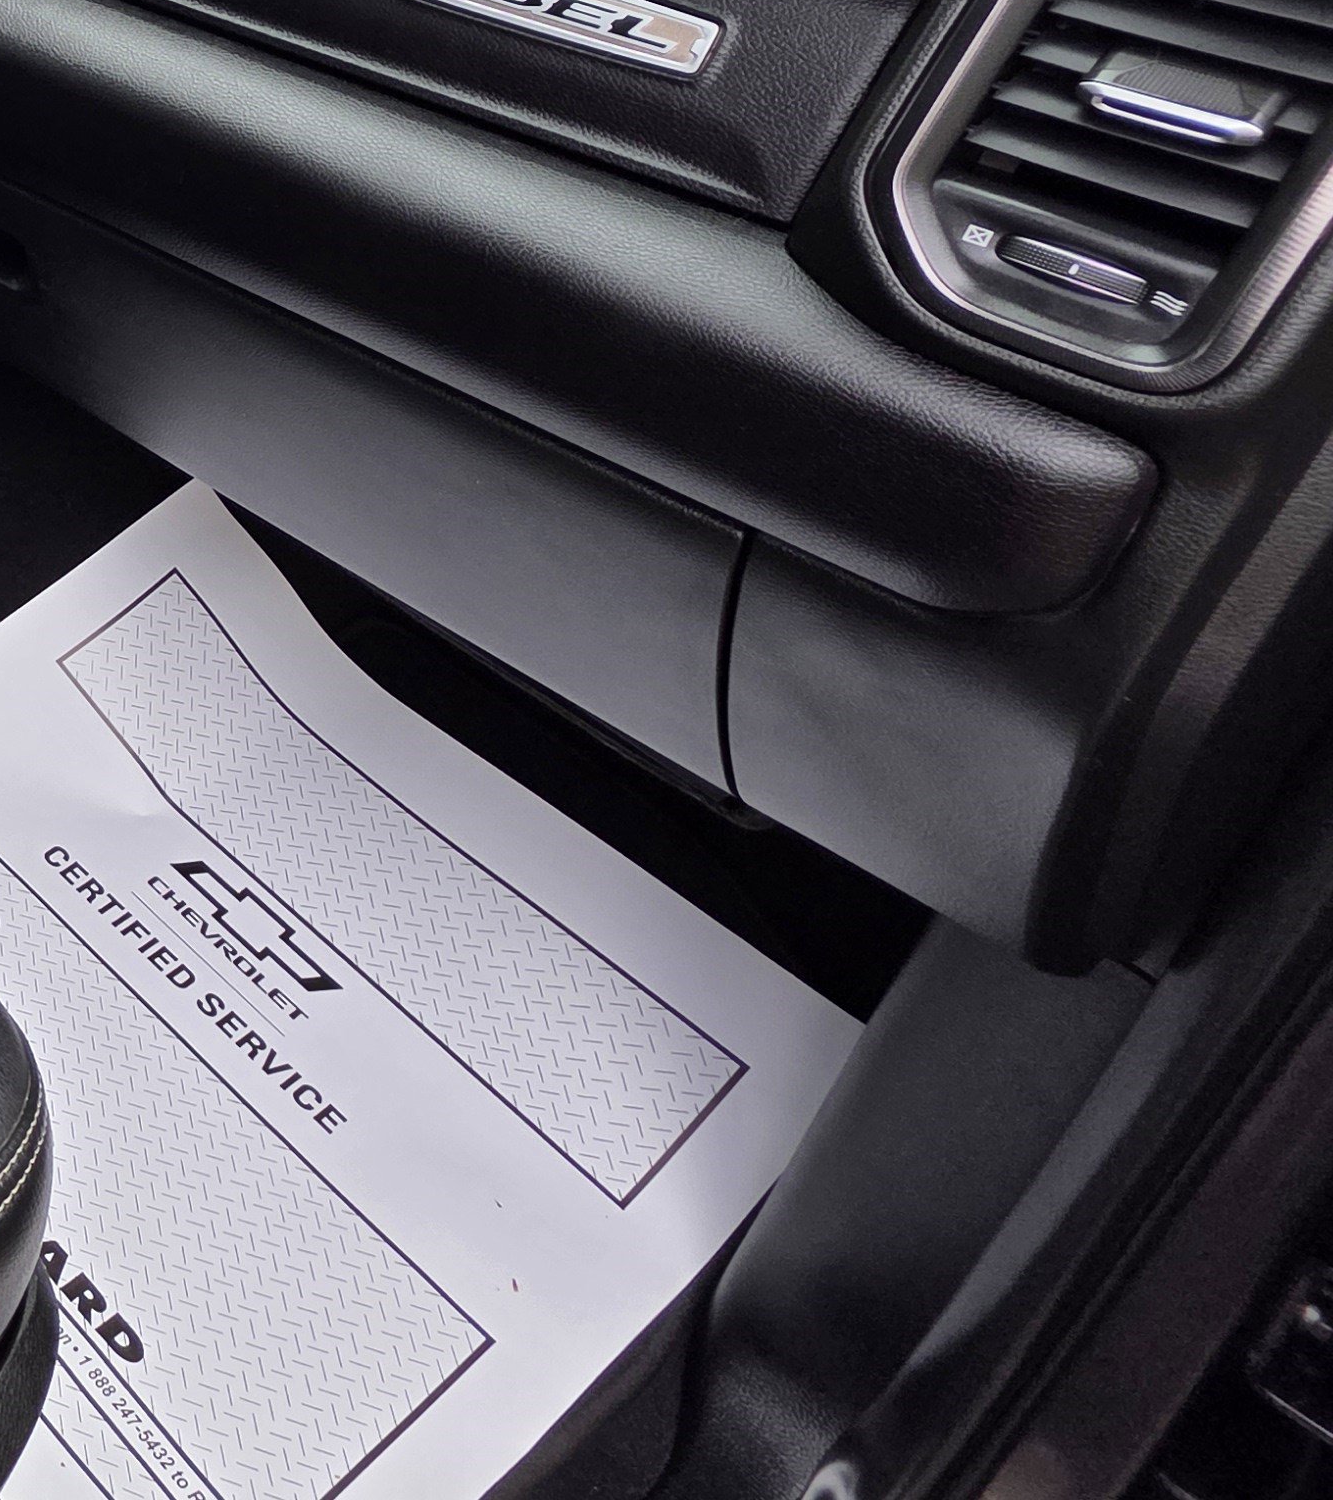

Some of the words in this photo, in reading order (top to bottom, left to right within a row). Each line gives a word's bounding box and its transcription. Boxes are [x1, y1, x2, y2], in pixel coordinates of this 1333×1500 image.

[44, 846, 196, 989] CERTIFIED
[196, 993, 348, 1135] SERVICE
[147, 875, 309, 1020] CHEVROLET
[88, 1368, 117, 1397] 888
[112, 1398, 175, 1470] 247-5432
[171, 1470, 189, 1489] to
